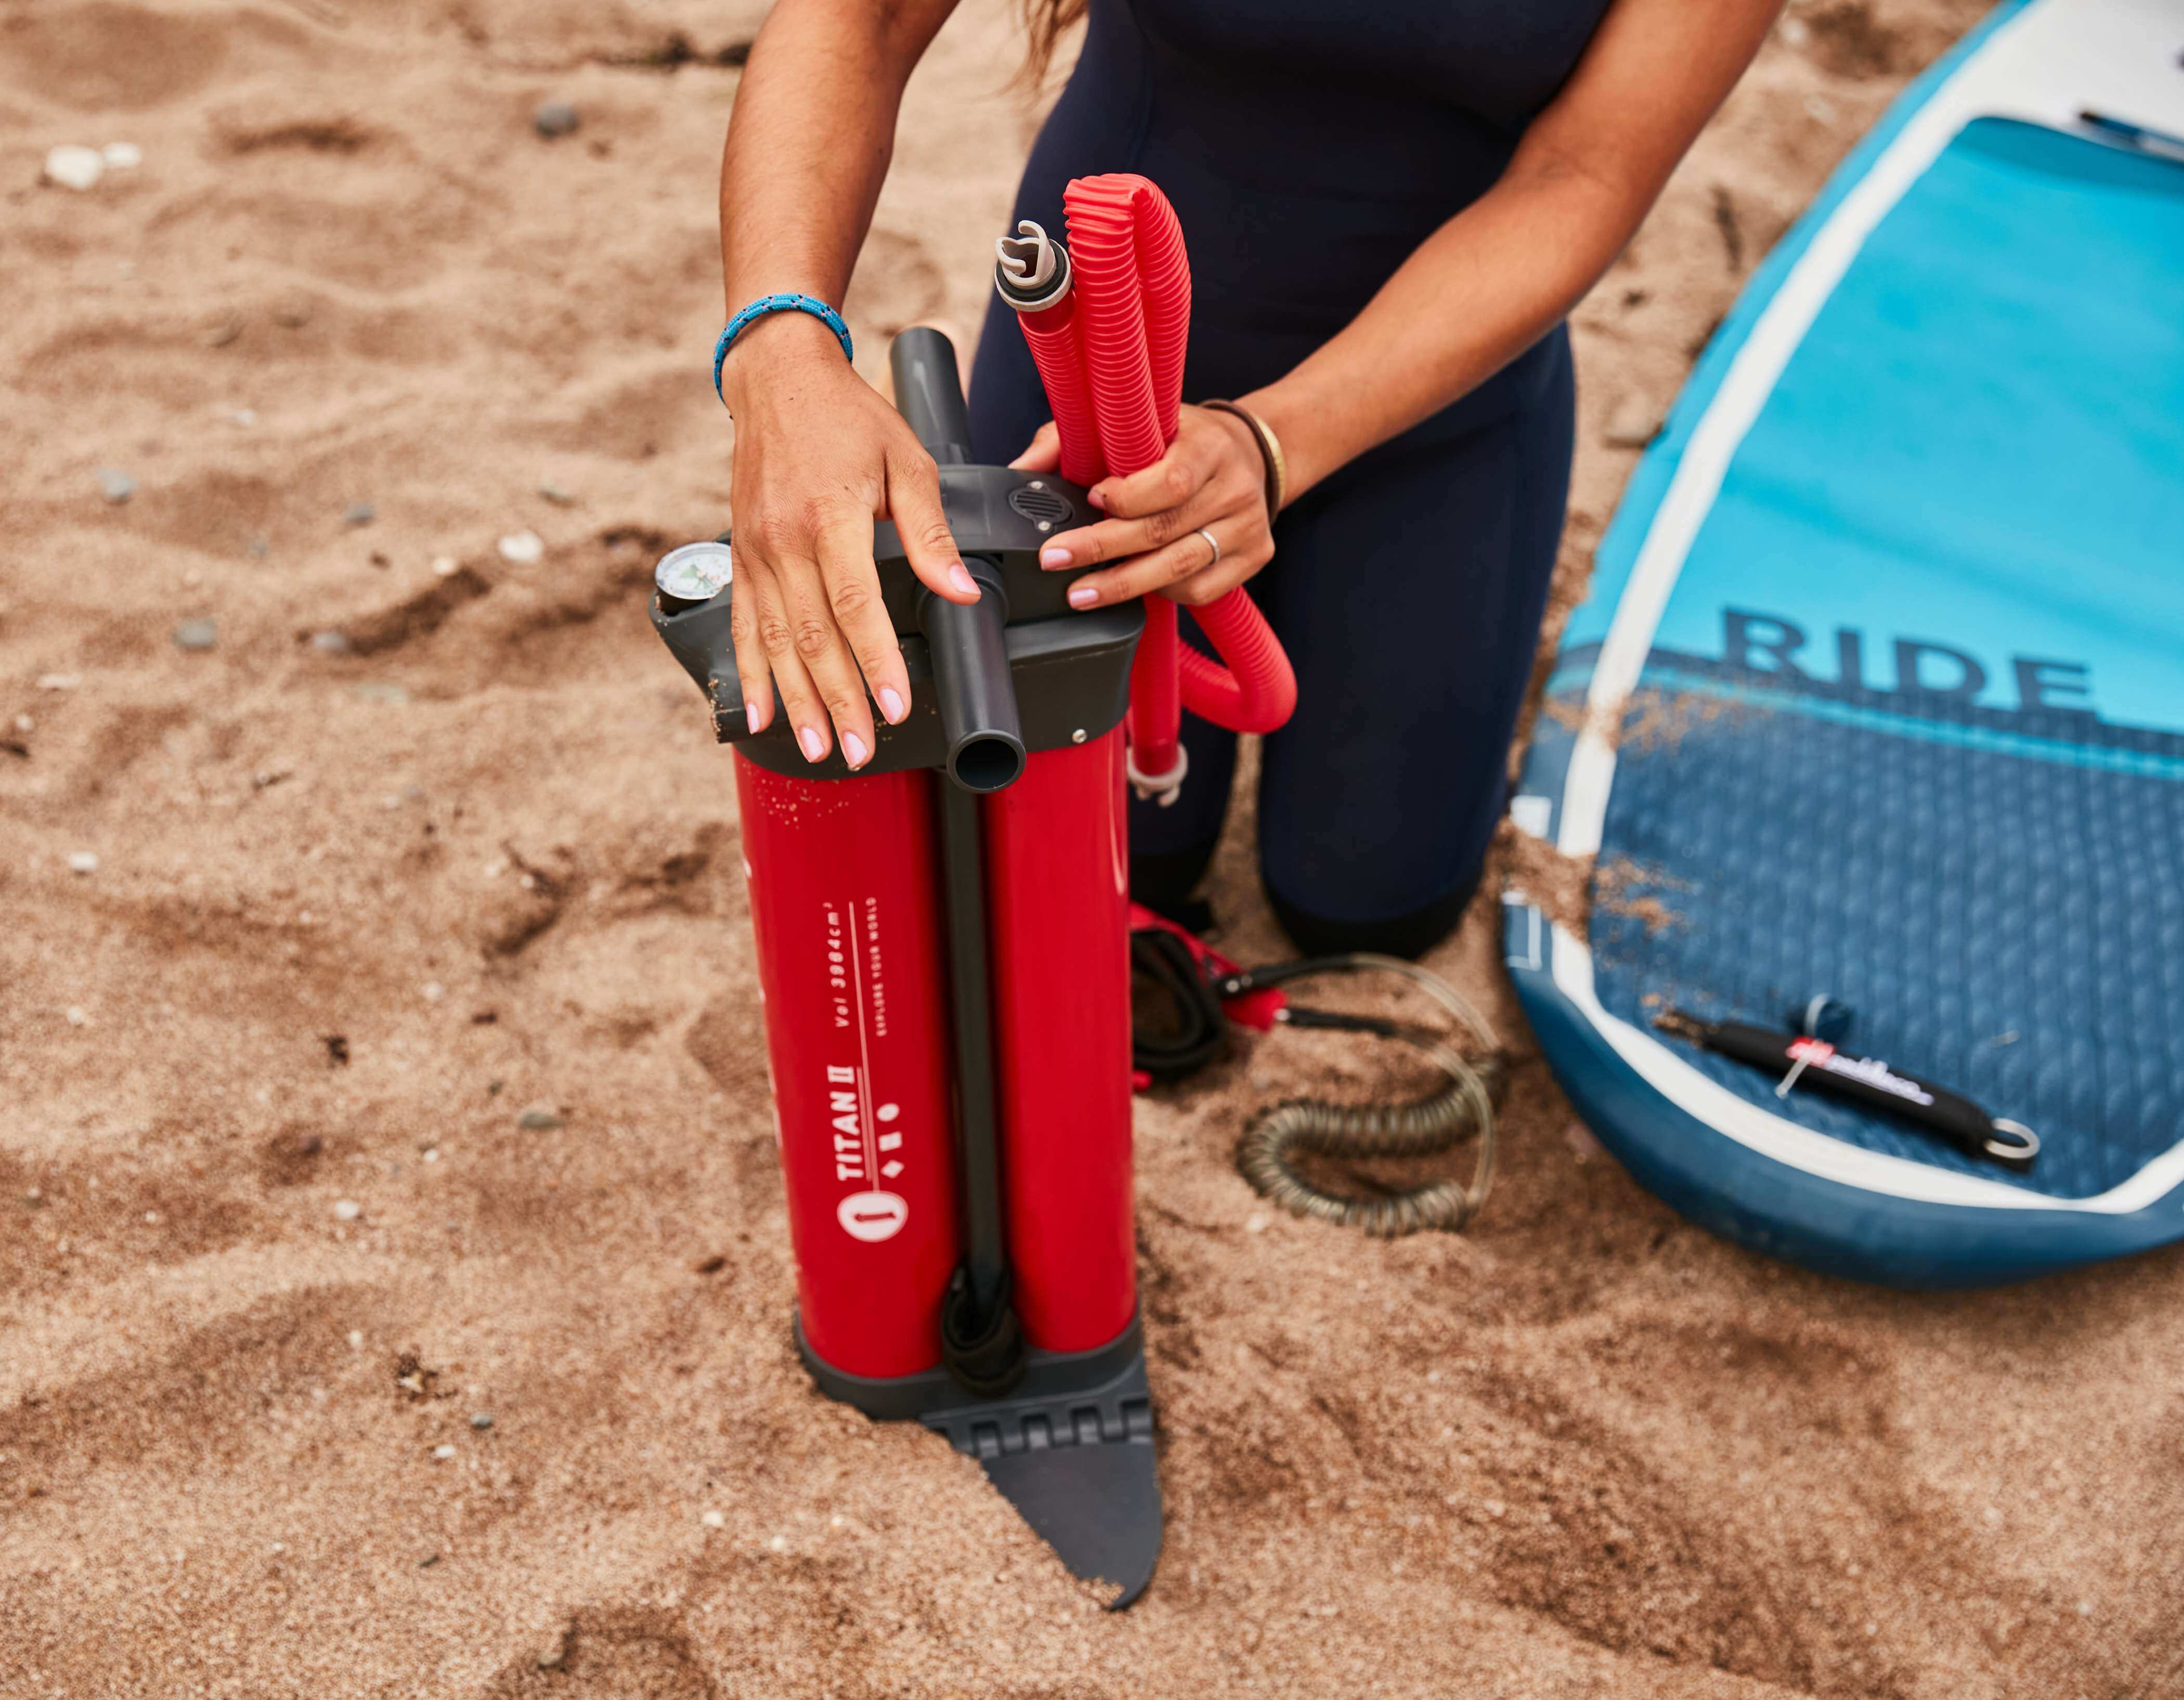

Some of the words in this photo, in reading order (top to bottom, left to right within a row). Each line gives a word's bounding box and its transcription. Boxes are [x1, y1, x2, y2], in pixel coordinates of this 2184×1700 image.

[1722, 606, 2098, 718] RIDE
[865, 897, 879, 941] WORLD
[869, 945, 882, 979] YOUR
[833, 997, 850, 1027] Vol
[873, 983, 887, 1037] EXPLORE
[827, 1065, 855, 1084] II
[830, 1091, 864, 1181] TITAN
